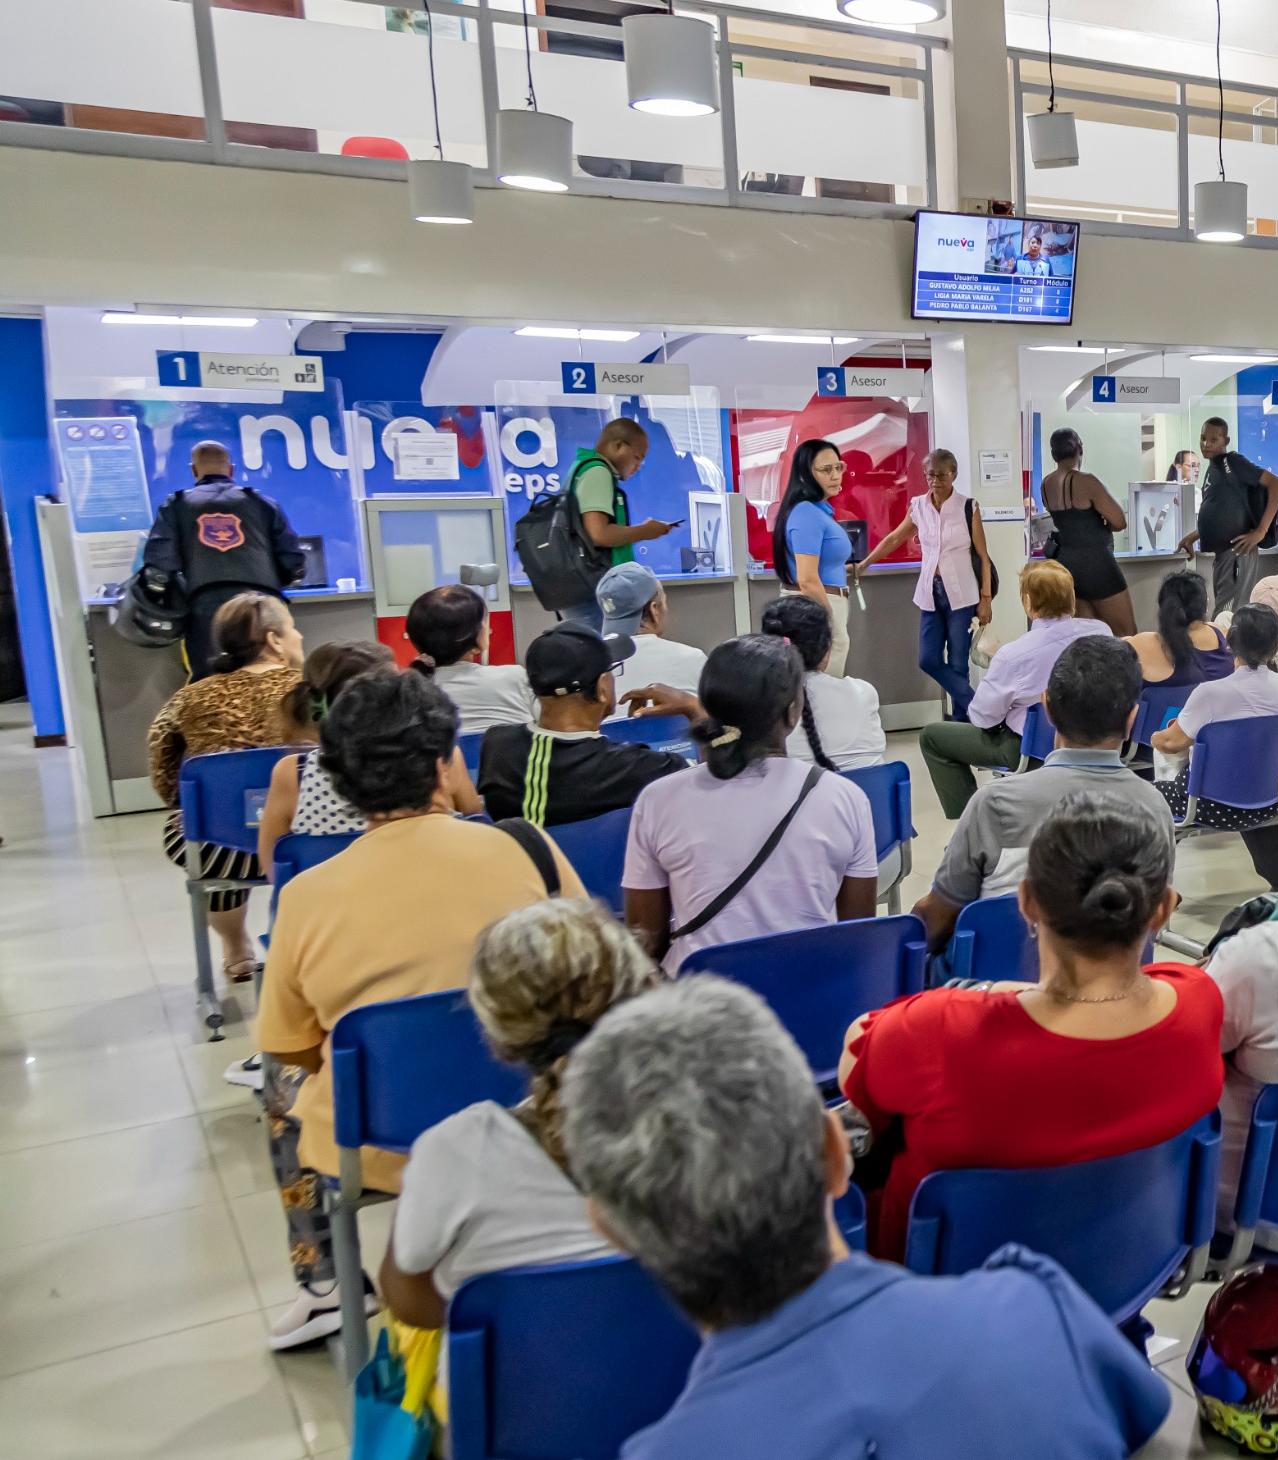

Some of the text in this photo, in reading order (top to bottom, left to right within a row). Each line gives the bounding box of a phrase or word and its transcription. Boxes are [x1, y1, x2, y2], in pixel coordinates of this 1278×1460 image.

[938, 237, 975, 248] nueva
[954, 273, 980, 282] Usuario
[1020, 277, 1038, 286] Turno
[1046, 278, 1069, 287] Módulo
[929, 281, 957, 290] GUSTAVO
[958, 283, 982, 292] ADOLFO
[951, 293, 972, 301] MARIA
[929, 301, 950, 309] PEDRO
[950, 302, 970, 310] PABLO
[173, 357, 280, 381] 1 Atención
[572, 367, 645, 389] 2 Asesor
[826, 372, 887, 392] 3 Asesor
[1098, 380, 1149, 398] 4 Asesor
[504, 472, 561, 500] eps
